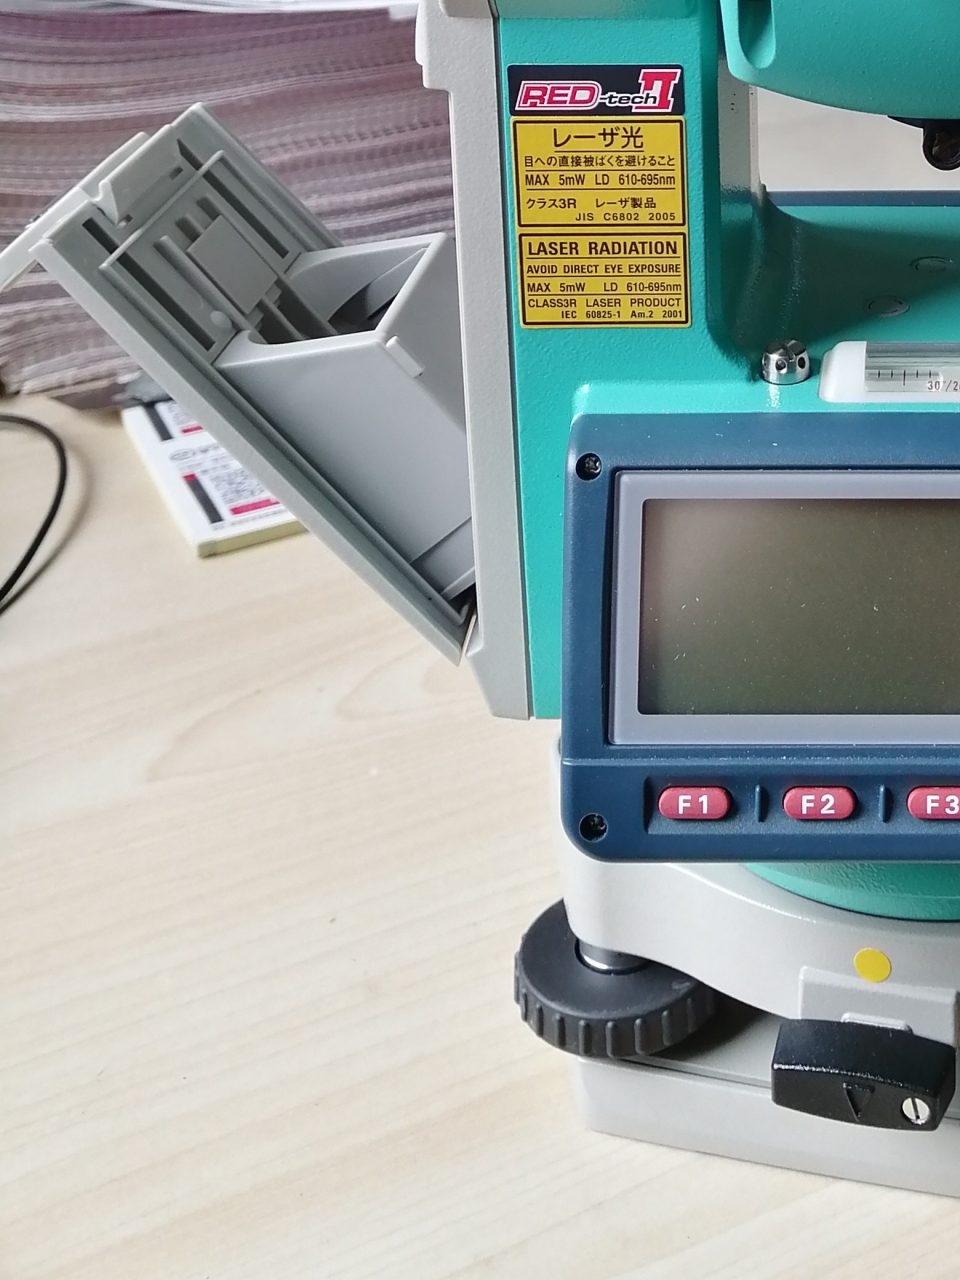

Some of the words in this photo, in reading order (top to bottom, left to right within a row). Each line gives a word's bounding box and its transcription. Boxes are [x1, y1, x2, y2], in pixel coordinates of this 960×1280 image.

[553, 126, 644, 149] レーザ光
[525, 174, 550, 186] MAX
[559, 174, 585, 186] 5mW
[595, 174, 609, 186] LD
[619, 173, 675, 185] 610-695nm
[526, 198, 577, 209] クラス3R
[595, 197, 657, 209] レーザ製品
[576, 212, 594, 221] JIS
[603, 212, 640, 221] C6802
[648, 212, 676, 221] 2005
[528, 241, 579, 256] LASER
[588, 241, 677, 255] RADIATION
[527, 264, 558, 274] AVOID
[563, 264, 599, 274] DIRECT
[604, 264, 623, 273] EYE
[628, 264, 681, 273] EXPOSURE
[527, 282, 551, 293] MAX
[559, 282, 586, 292] 5mW
[603, 282, 618, 292] LD
[626, 282, 682, 292] 610-695nm
[528, 298, 577, 308] CLASS3R
[586, 298, 621, 308] LASER
[630, 298, 681, 307] PRODUCT
[561, 311, 577, 319] IEC
[586, 310, 621, 319] 60825-1
[630, 310, 654, 319] Am.2
[662, 310, 682, 318] 2001
[678, 795, 708, 814] F1
[801, 795, 836, 814] F2
[926, 795, 960, 814] F3
